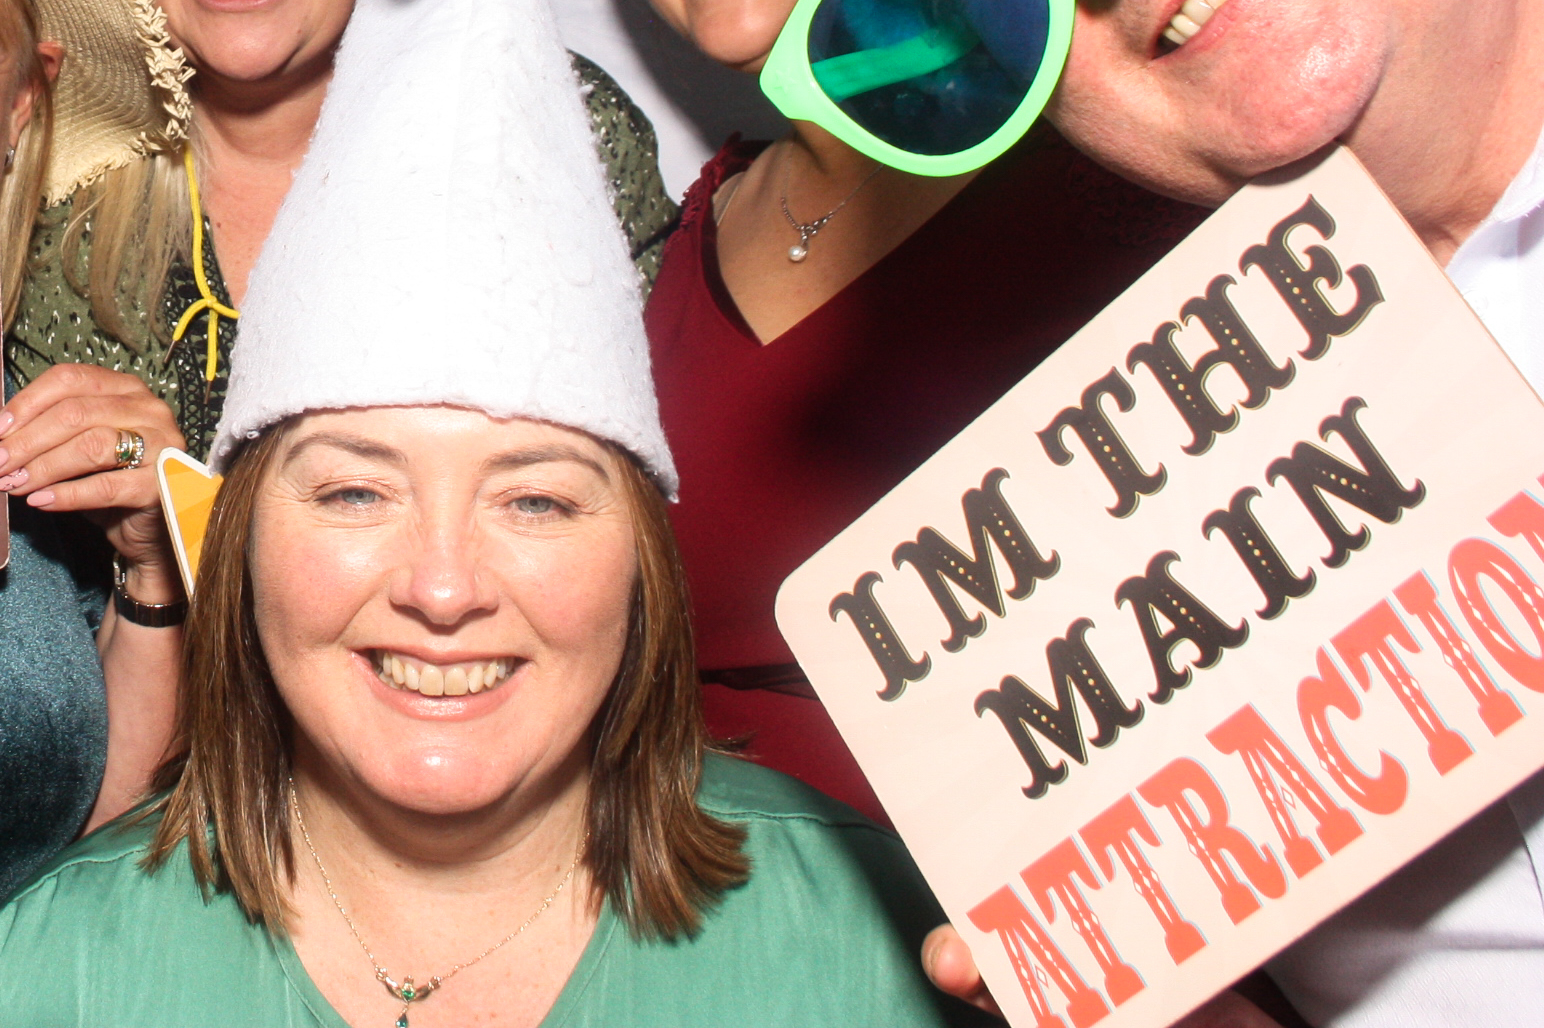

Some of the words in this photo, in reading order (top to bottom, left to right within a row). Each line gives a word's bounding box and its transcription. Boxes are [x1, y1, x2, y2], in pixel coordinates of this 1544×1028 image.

[828, 467, 1062, 702] IM
[1035, 193, 1386, 519] THE
[973, 396, 1427, 800] MAIN
